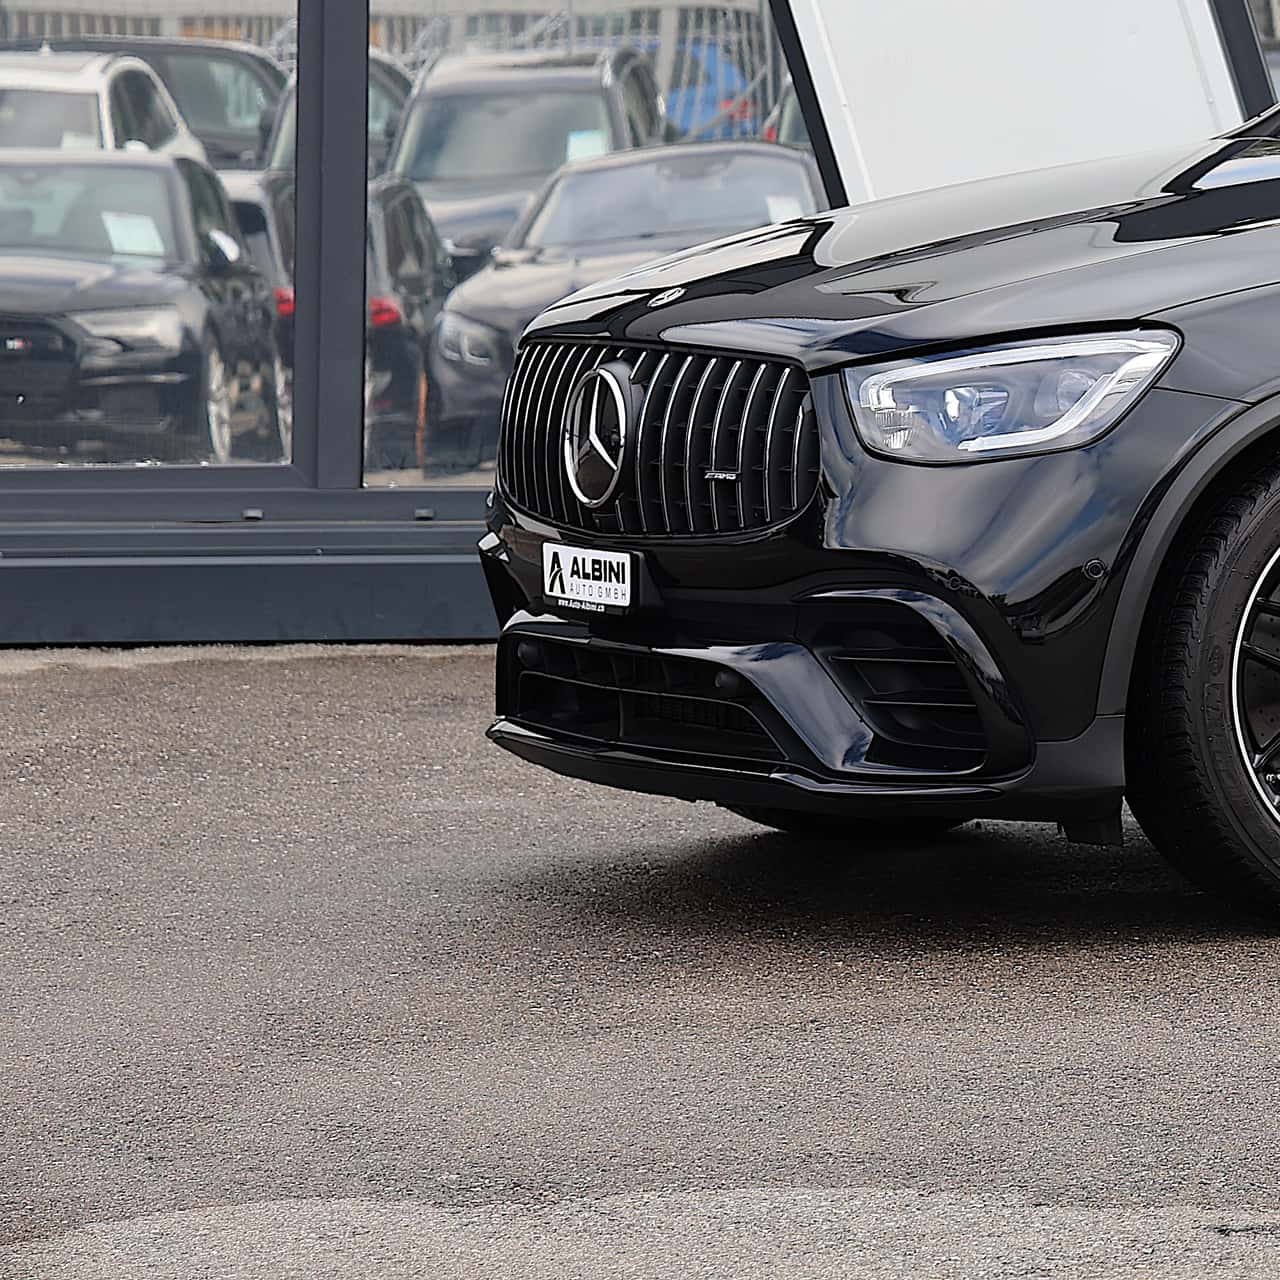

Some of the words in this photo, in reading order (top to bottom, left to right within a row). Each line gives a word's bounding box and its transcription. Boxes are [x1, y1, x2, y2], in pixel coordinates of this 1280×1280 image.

[570, 556, 626, 585] ALBINI
[569, 582, 594, 598] AUTO
[597, 585, 627, 602] GMBH
